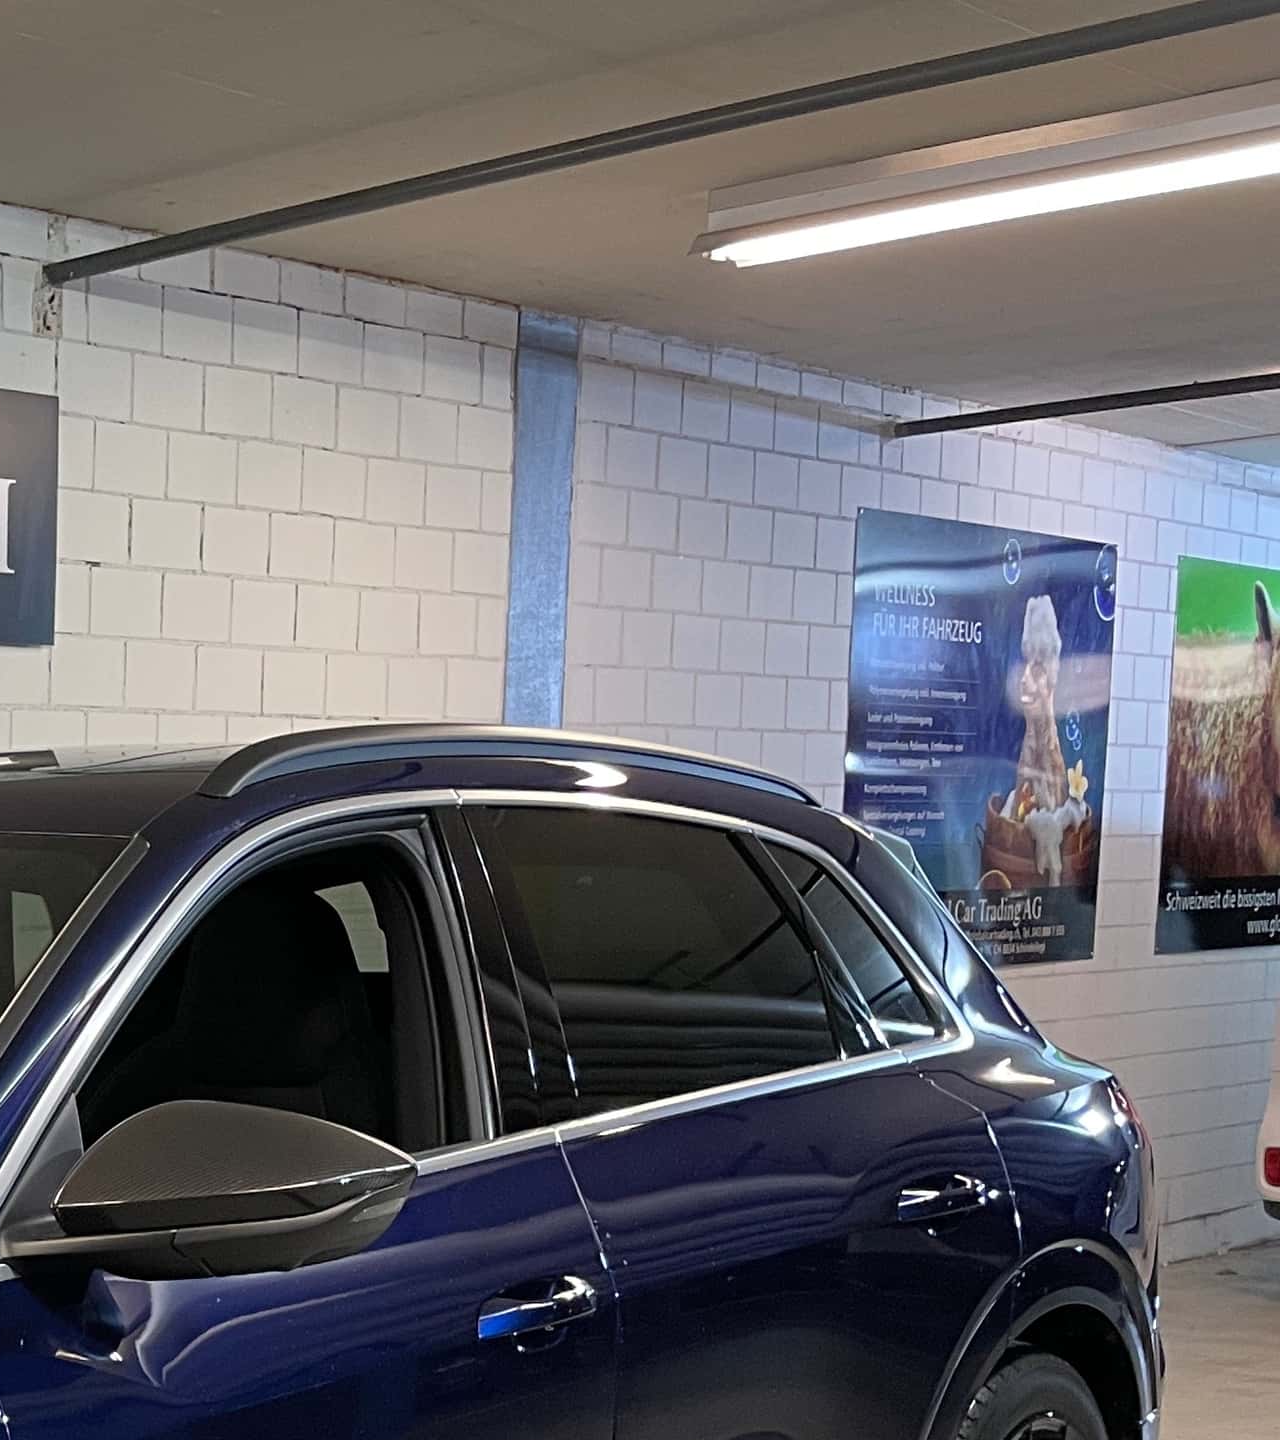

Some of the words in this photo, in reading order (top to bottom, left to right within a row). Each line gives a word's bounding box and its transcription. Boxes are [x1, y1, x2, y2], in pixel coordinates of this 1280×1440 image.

[874, 584, 936, 607] WELLNESS
[873, 607, 896, 637] FÜR
[899, 615, 919, 639] IHR
[922, 617, 982, 643] FAHRZEUG
[954, 899, 976, 924] Car
[978, 896, 1022, 927] Trading
[1022, 896, 1042, 921] AG
[1222, 888, 1236, 908] die
